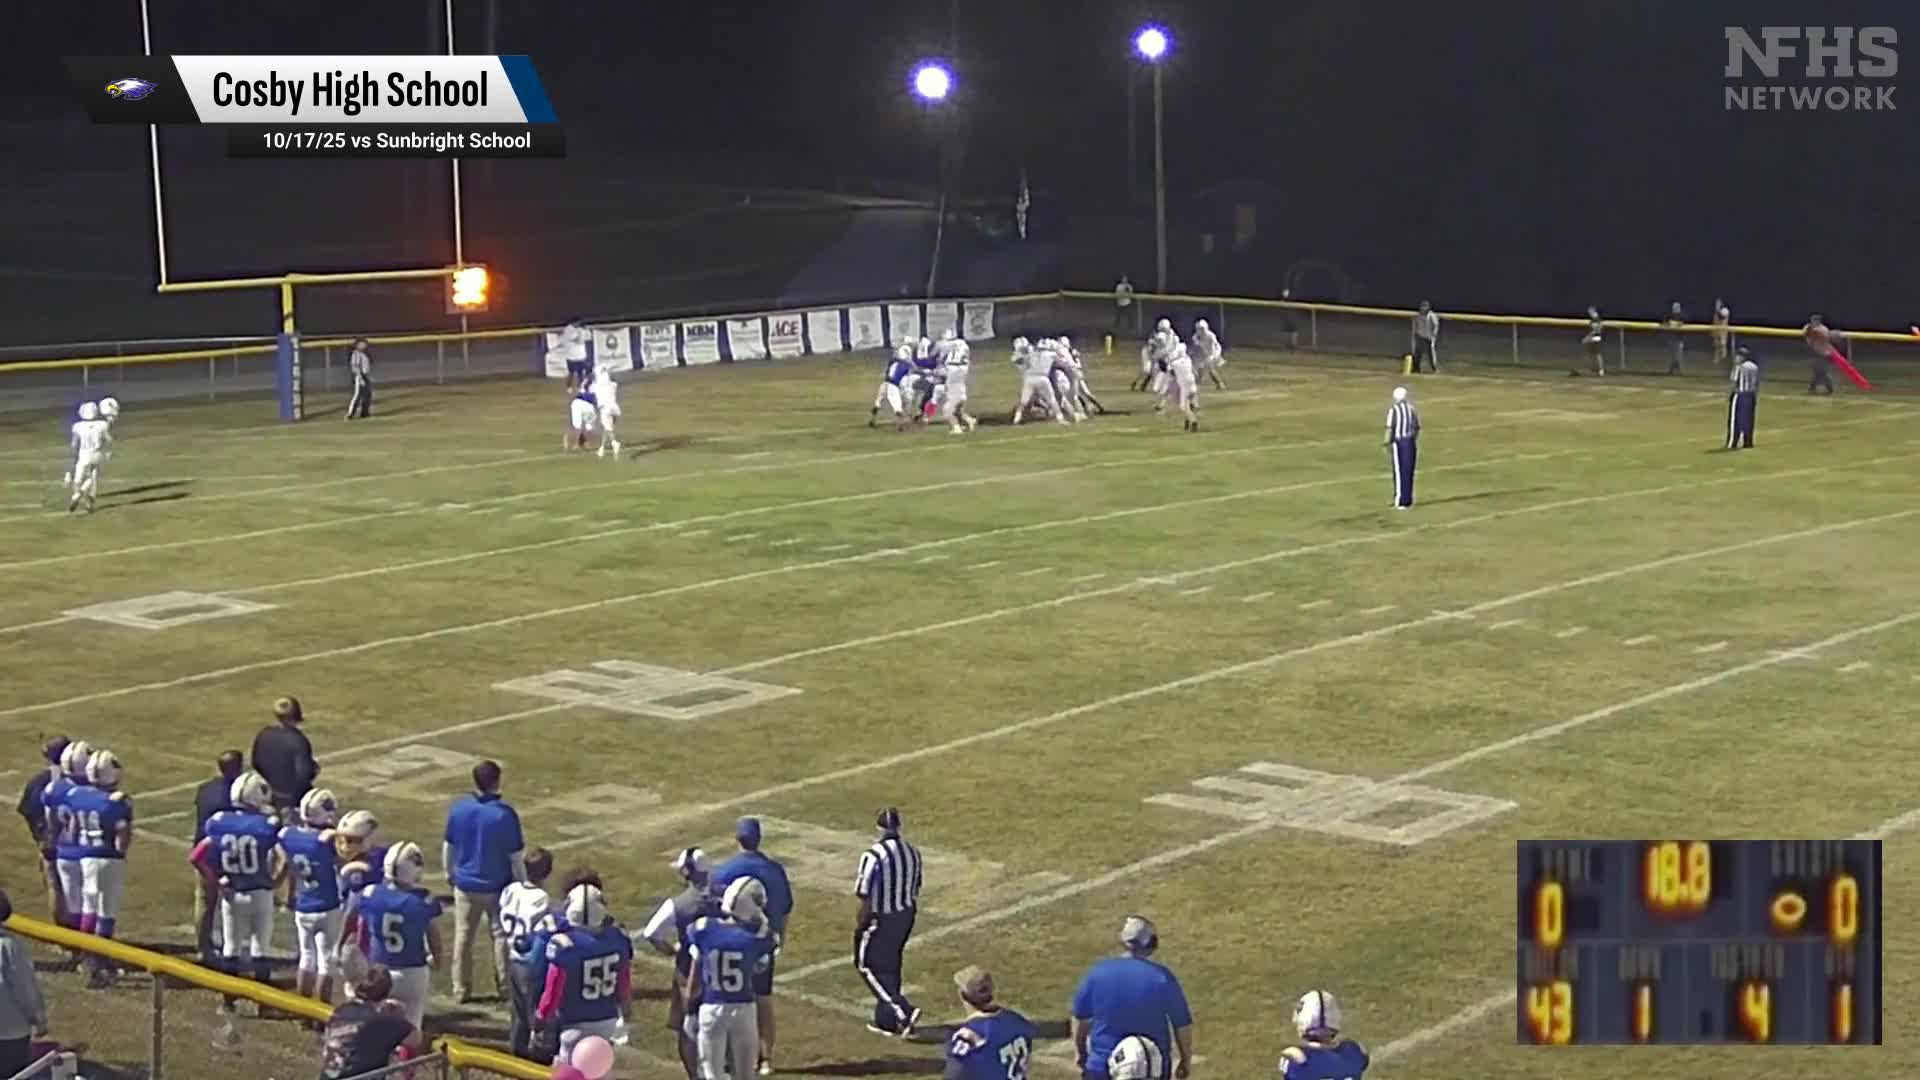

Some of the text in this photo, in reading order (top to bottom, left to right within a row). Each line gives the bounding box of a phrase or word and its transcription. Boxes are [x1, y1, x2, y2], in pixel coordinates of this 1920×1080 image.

[772, 320, 799, 337] ACE
[221, 834, 259, 874] 20
[1644, 841, 1711, 907] 18.8
[382, 911, 405, 953] 5
[1536, 880, 1564, 946] 0
[1832, 875, 1858, 940] 0
[582, 953, 620, 1000] 55
[704, 948, 744, 993] 15
[1527, 980, 1573, 1043] 43
[1741, 983, 1769, 1041] 4
